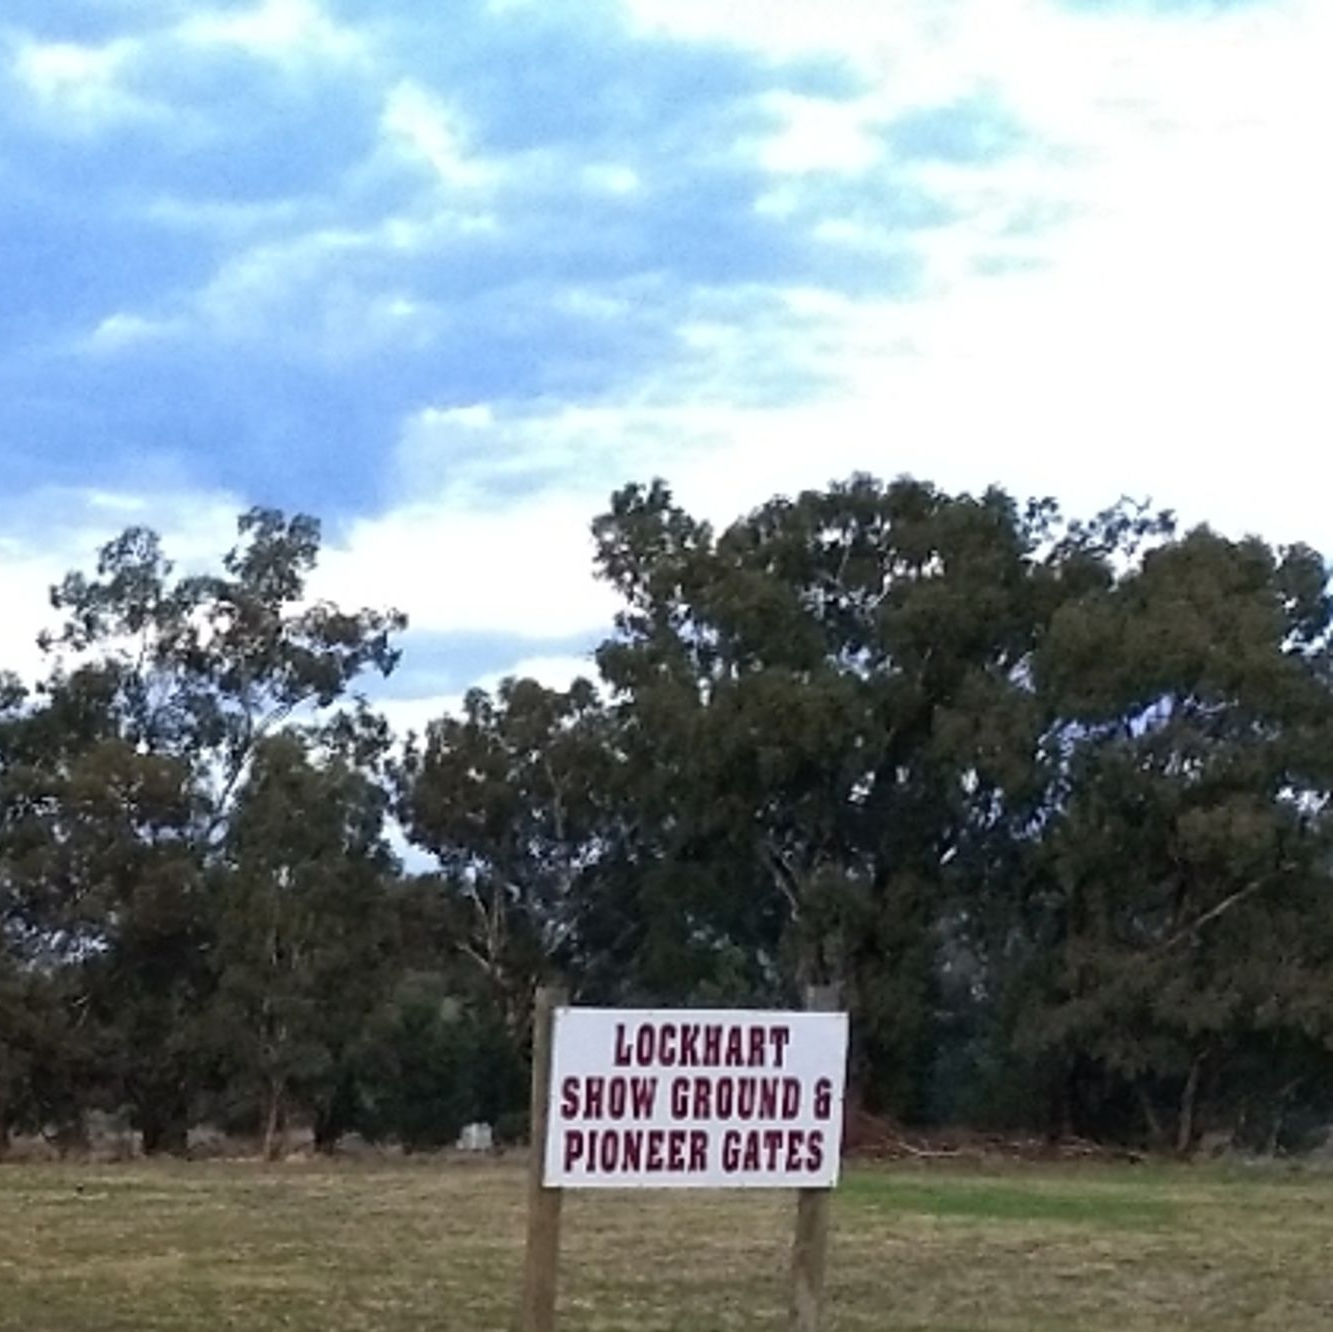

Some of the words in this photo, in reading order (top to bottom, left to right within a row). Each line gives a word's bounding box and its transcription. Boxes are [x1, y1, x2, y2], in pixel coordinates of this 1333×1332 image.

[614, 1023, 790, 1067] LOCKHART
[561, 1077, 657, 1120] SHOW
[671, 1077, 801, 1120] GROUND
[814, 1078, 833, 1120] &
[563, 1130, 708, 1172] PIONEER
[721, 1130, 824, 1172] GATES
